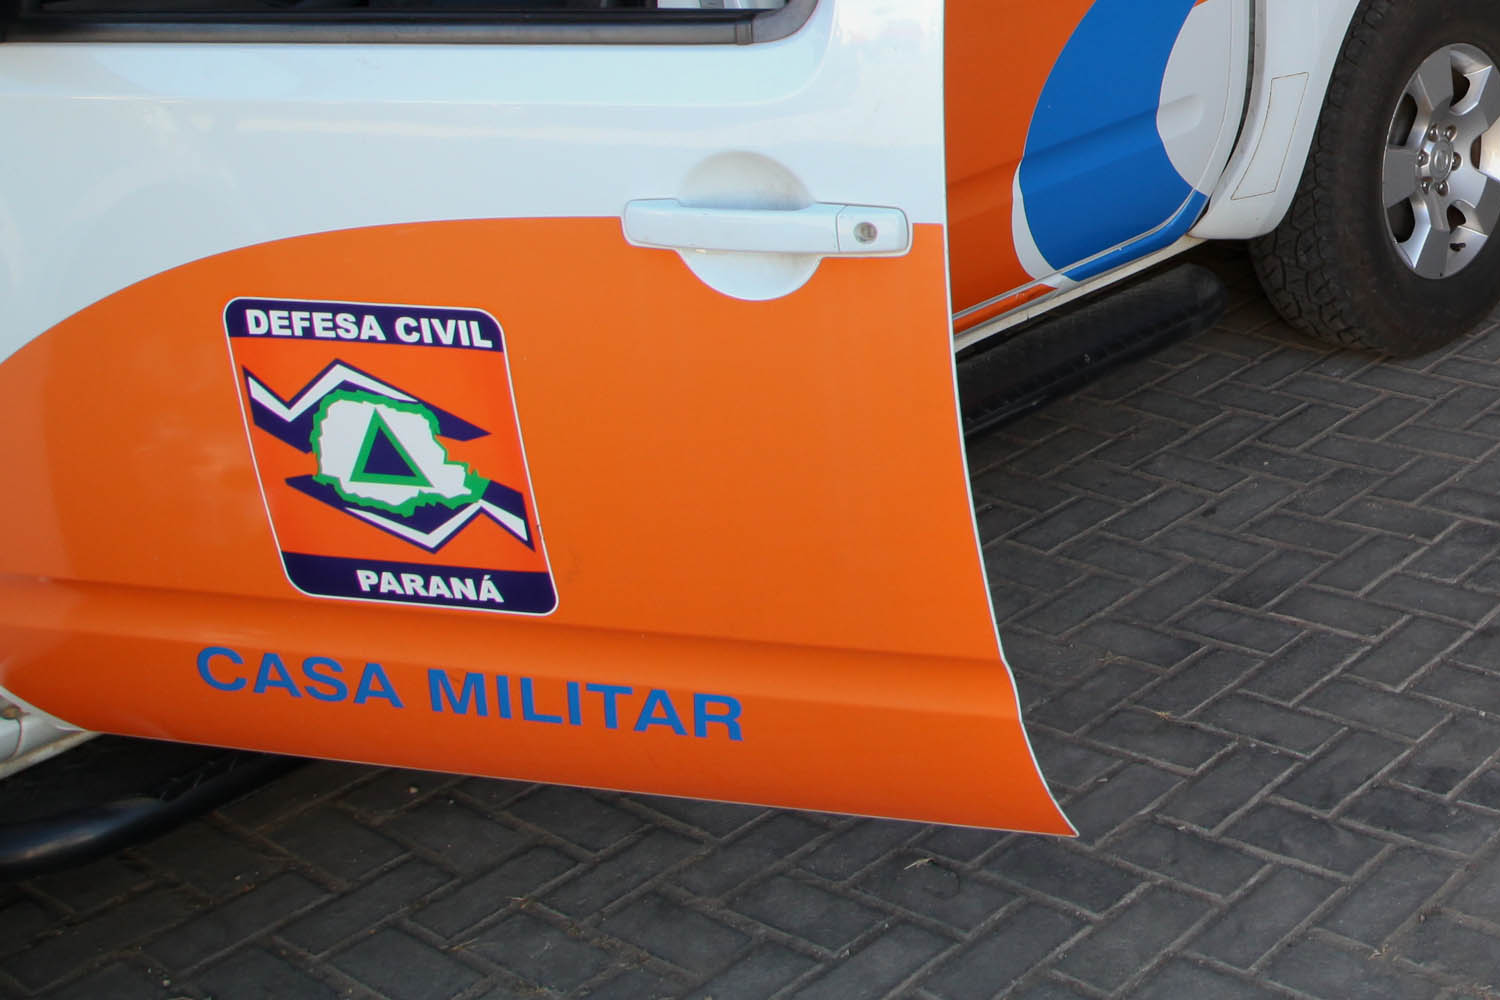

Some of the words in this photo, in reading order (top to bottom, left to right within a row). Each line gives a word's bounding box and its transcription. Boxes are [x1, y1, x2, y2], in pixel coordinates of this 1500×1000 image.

[245, 308, 387, 342] DEFESA
[394, 316, 493, 349] CIVIL
[355, 568, 505, 603] PARANÁ
[195, 646, 405, 710] CASA
[427, 667, 744, 742] MILITAR
